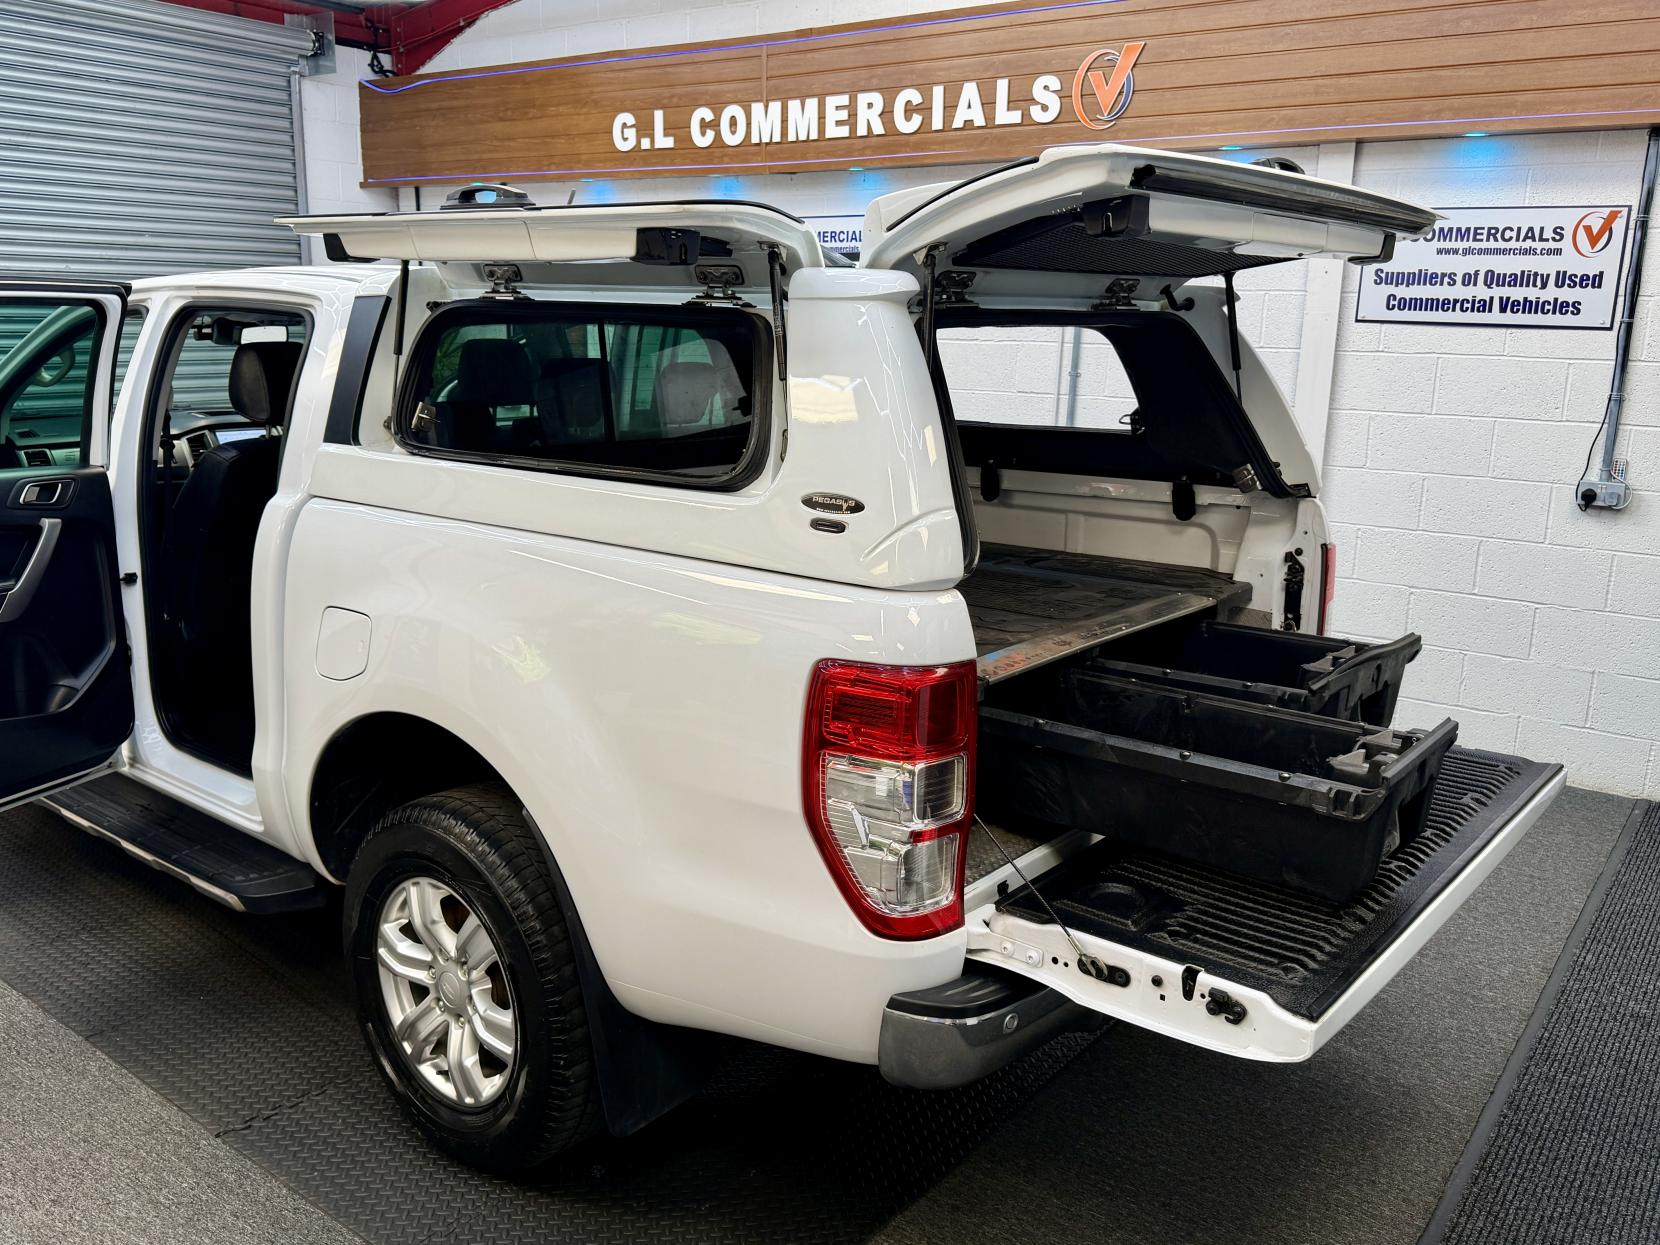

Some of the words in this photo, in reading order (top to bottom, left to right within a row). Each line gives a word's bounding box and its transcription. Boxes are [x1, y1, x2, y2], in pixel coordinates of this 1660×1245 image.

[612, 109, 675, 152] G.L
[690, 74, 1063, 148] COMMERCIALS
[1410, 225, 1565, 243] OMMERCIALS
[1436, 245, 1563, 257] www.glcommercials.com
[1373, 267, 1457, 288] Suppliers
[1462, 268, 1480, 287] of
[1483, 269, 1551, 290] Quality
[1554, 270, 1604, 289] Used
[1385, 293, 1494, 314] Commercial
[1499, 296, 1582, 316] Vehicles
[812, 496, 856, 507] PEGASUS
